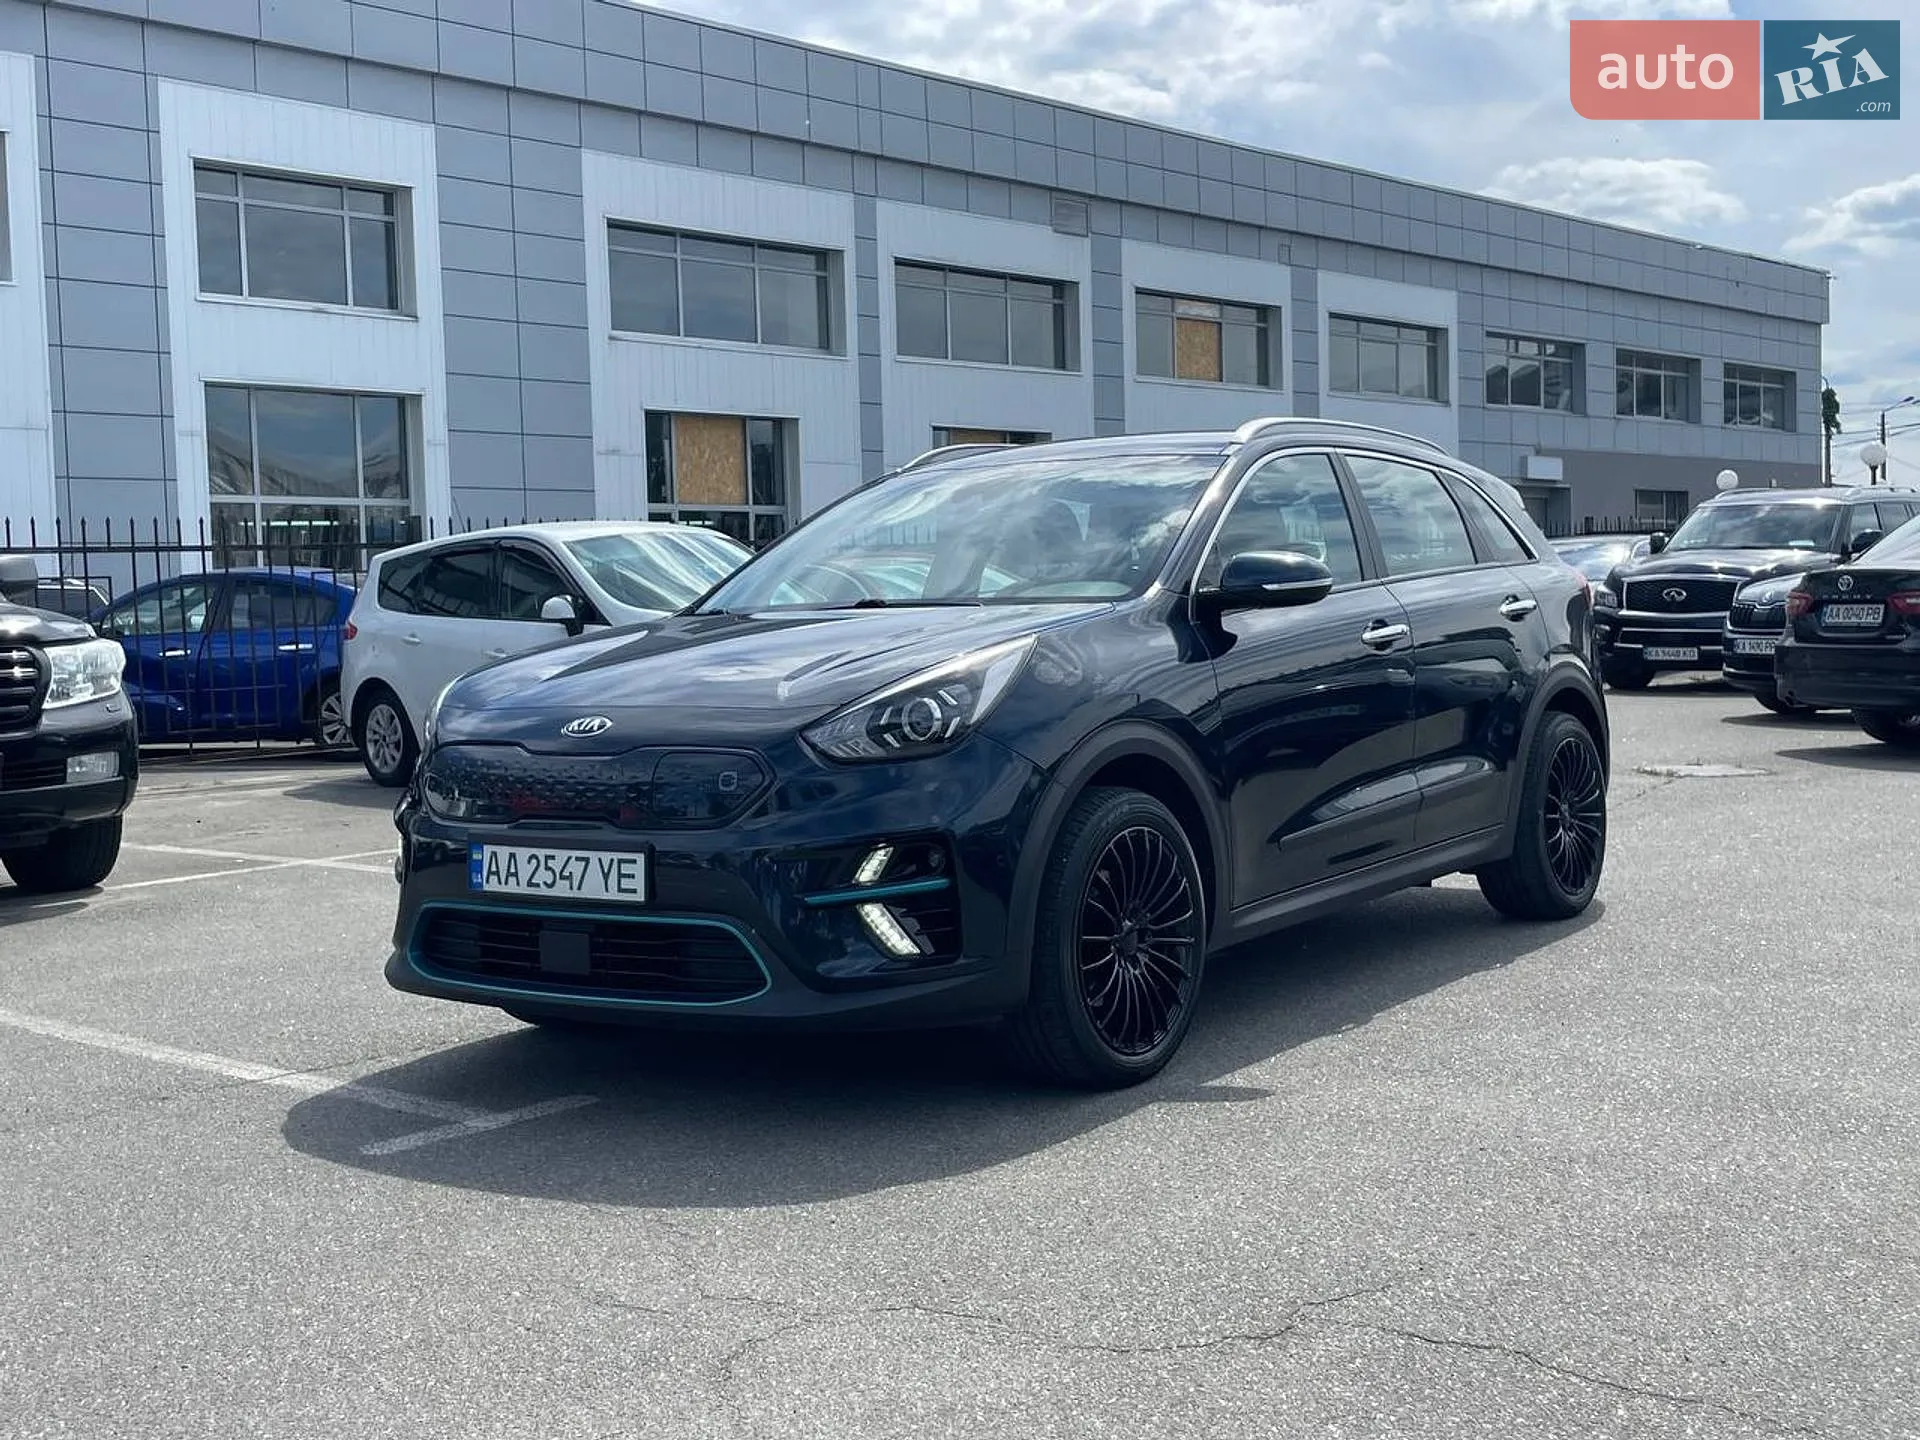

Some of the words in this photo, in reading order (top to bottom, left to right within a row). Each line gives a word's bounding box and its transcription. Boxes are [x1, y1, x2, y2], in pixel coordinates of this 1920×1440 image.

[566, 717, 603, 732] KIA
[485, 851, 521, 887] AA
[526, 853, 591, 891] 2547
[598, 857, 638, 894] YE
